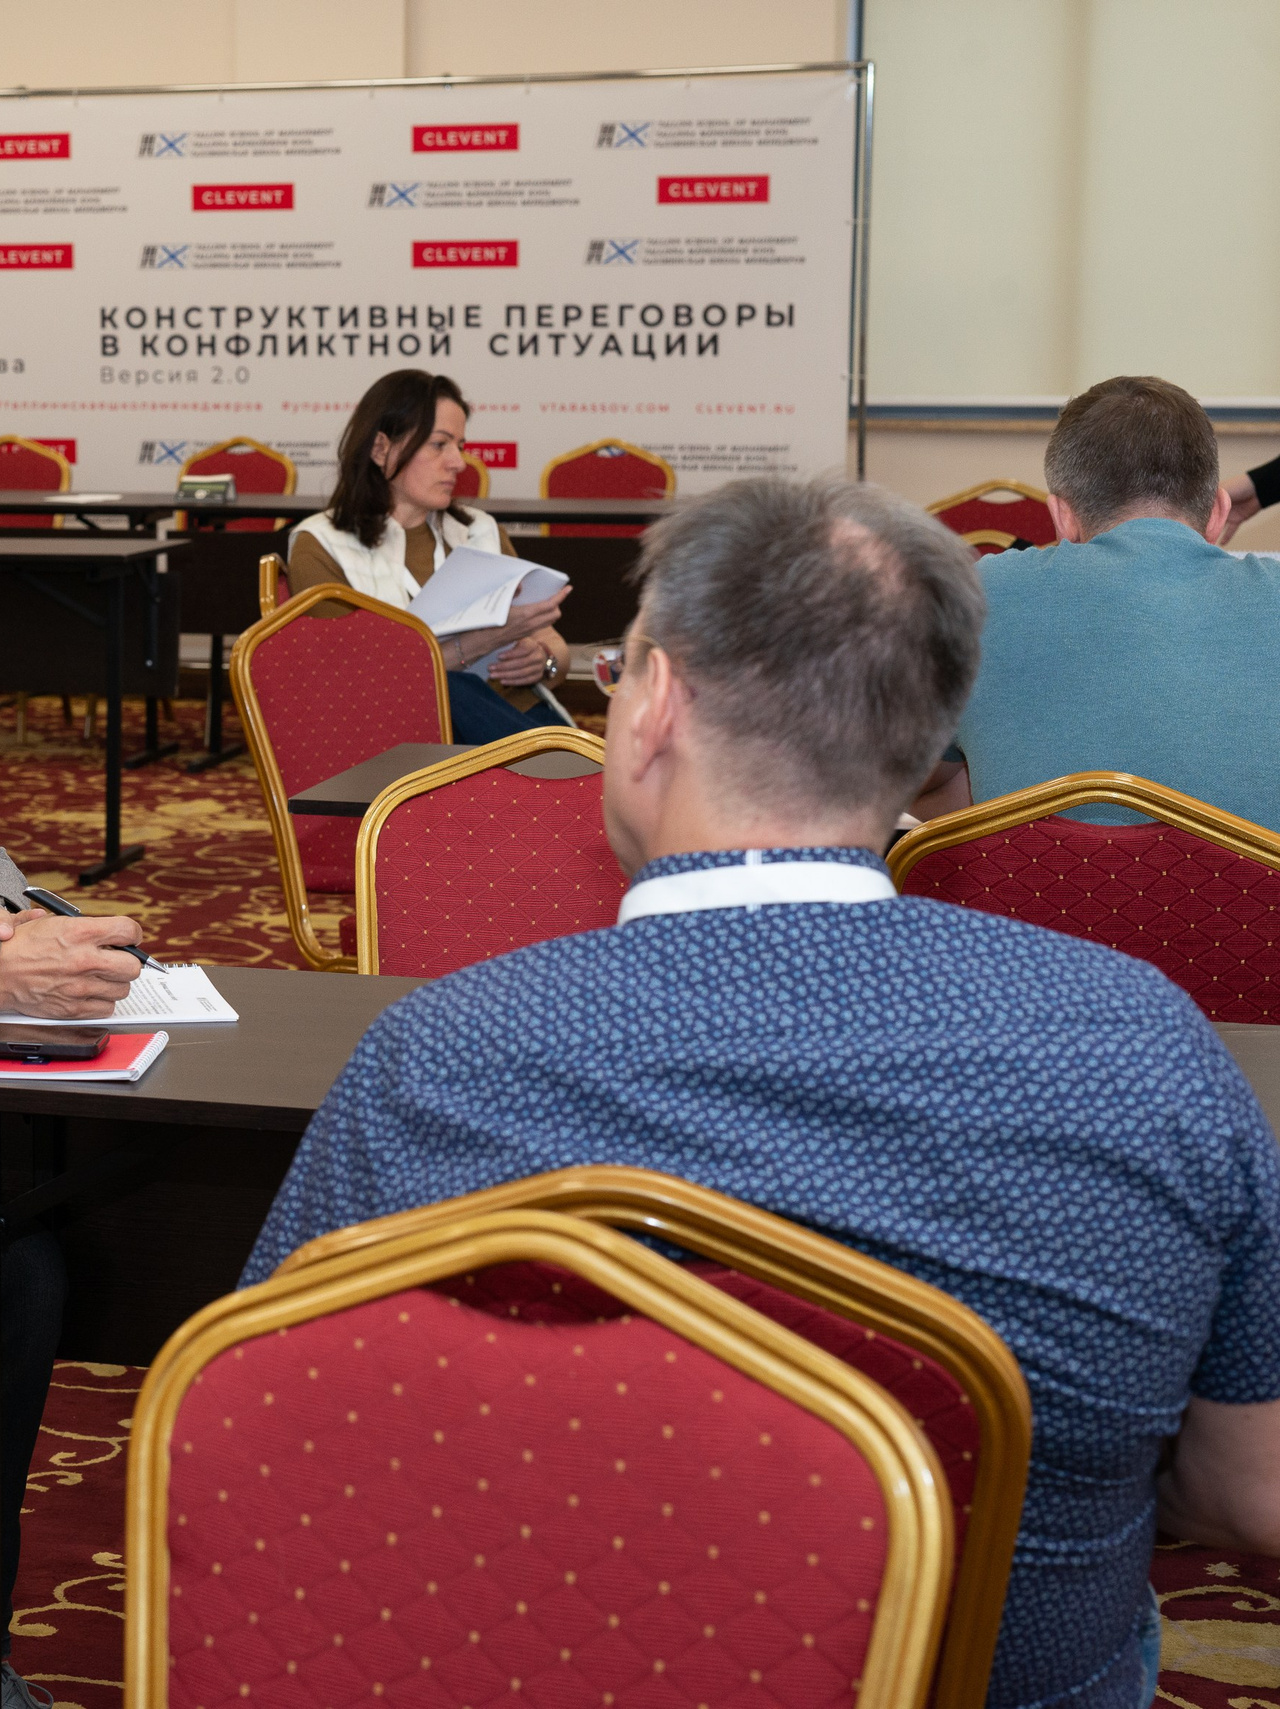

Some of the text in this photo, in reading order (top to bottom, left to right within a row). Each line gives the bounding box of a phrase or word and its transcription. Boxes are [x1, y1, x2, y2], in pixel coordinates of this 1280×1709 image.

[422, 130, 509, 147] CLEVENT
[201, 189, 285, 206] CLEVENT
[667, 181, 759, 198] CLEVENT
[421, 246, 508, 263] CLEVENT
[100, 303, 795, 329] КОНСТРУКТИВНЫЕ ПЕРЕГОВОРЫ
[101, 327, 720, 362] В КОНФЛИКТНОЙ СИТУАЦИИ
[99, 365, 251, 387] Версия 2.0
